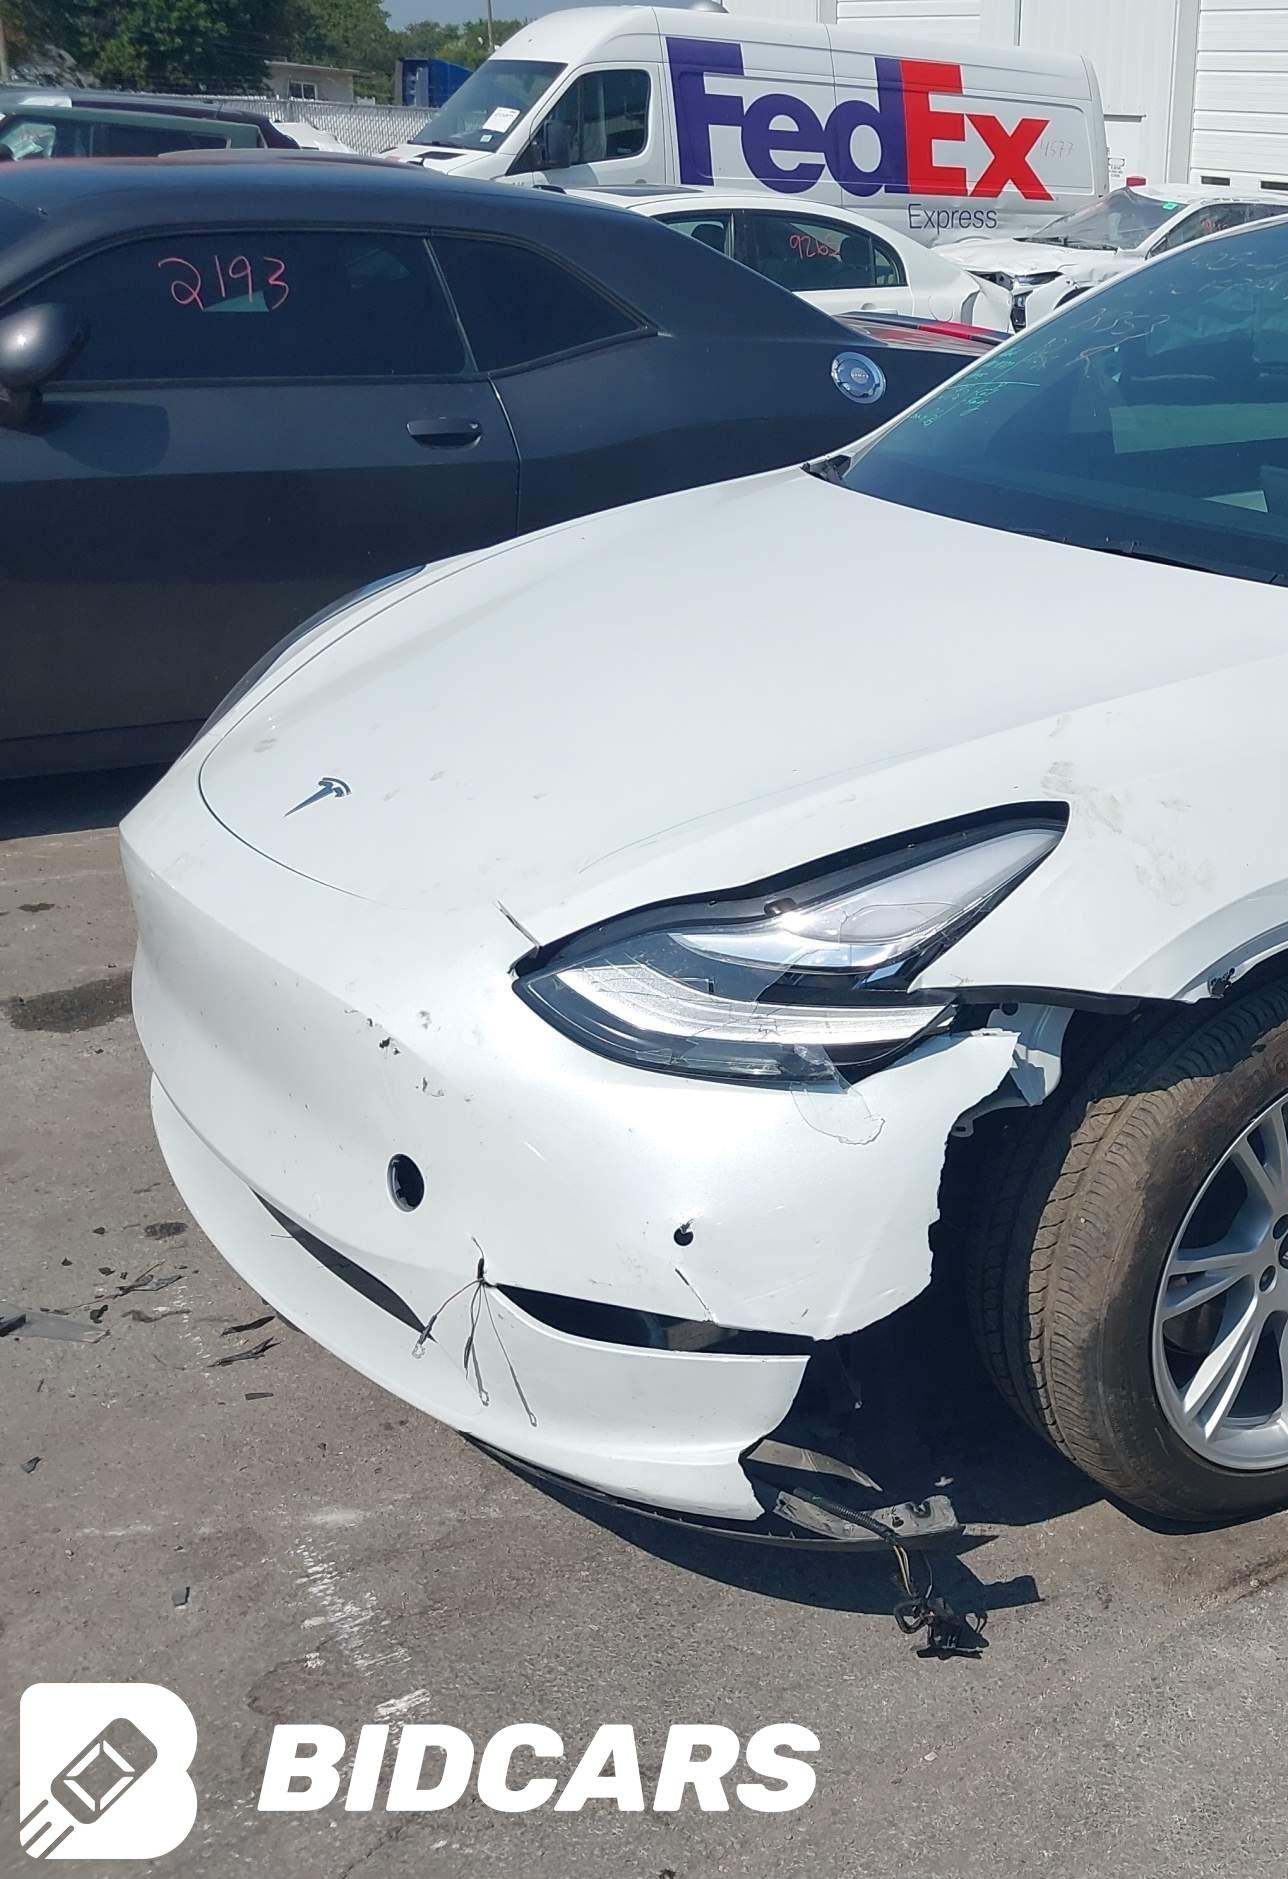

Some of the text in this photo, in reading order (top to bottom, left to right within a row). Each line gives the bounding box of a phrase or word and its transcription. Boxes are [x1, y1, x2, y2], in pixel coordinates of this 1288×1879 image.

[666, 36, 1056, 200] FedEx
[908, 203, 998, 231] Express
[158, 255, 289, 311] 2193
